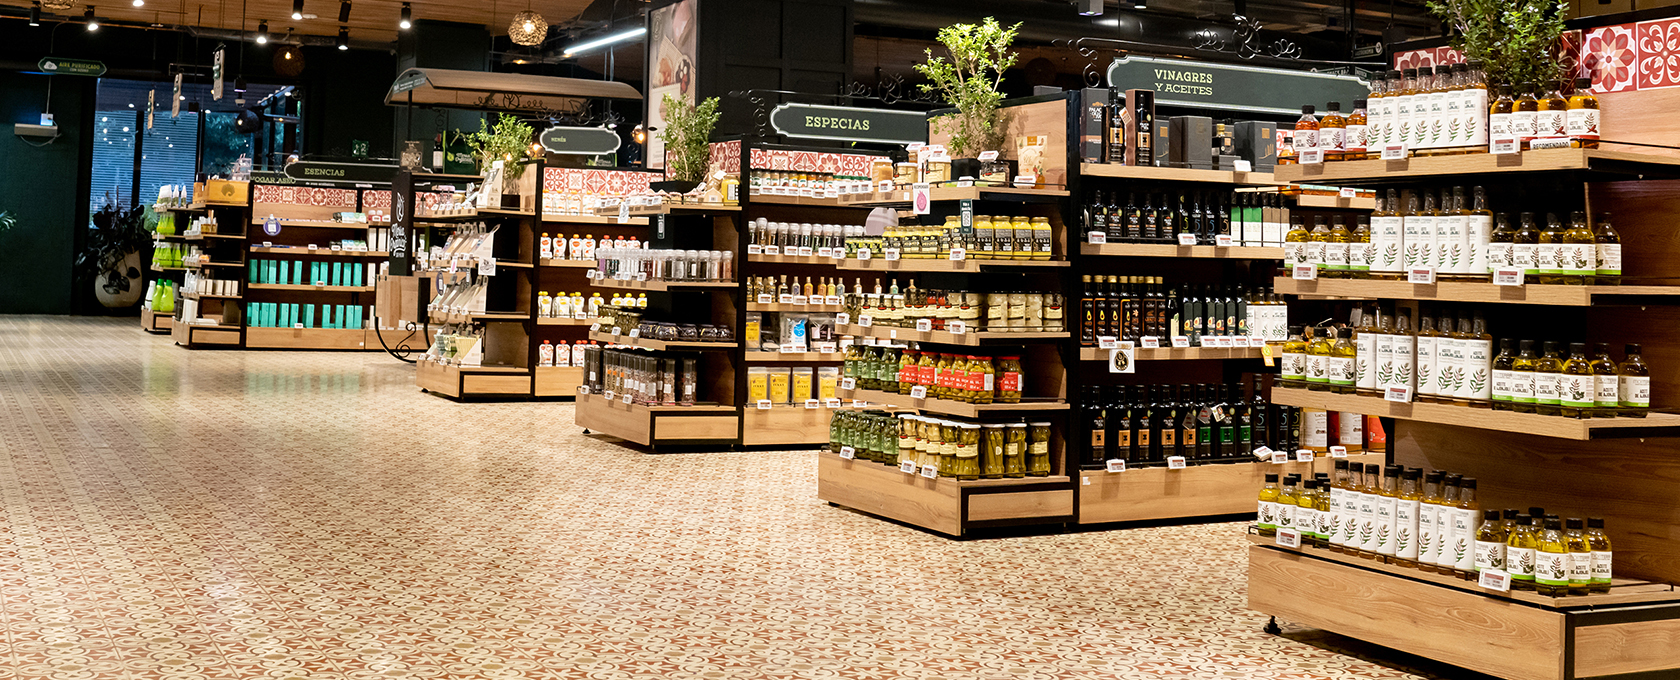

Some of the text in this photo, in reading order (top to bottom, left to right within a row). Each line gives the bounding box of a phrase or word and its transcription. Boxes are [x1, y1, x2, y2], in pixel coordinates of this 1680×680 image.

[1154, 69, 1213, 84] VINAGRES
[1154, 82, 1213, 96] Y ACEITES
[805, 116, 870, 130] ESPECIAS
[304, 168, 346, 176] ESENCIAS
